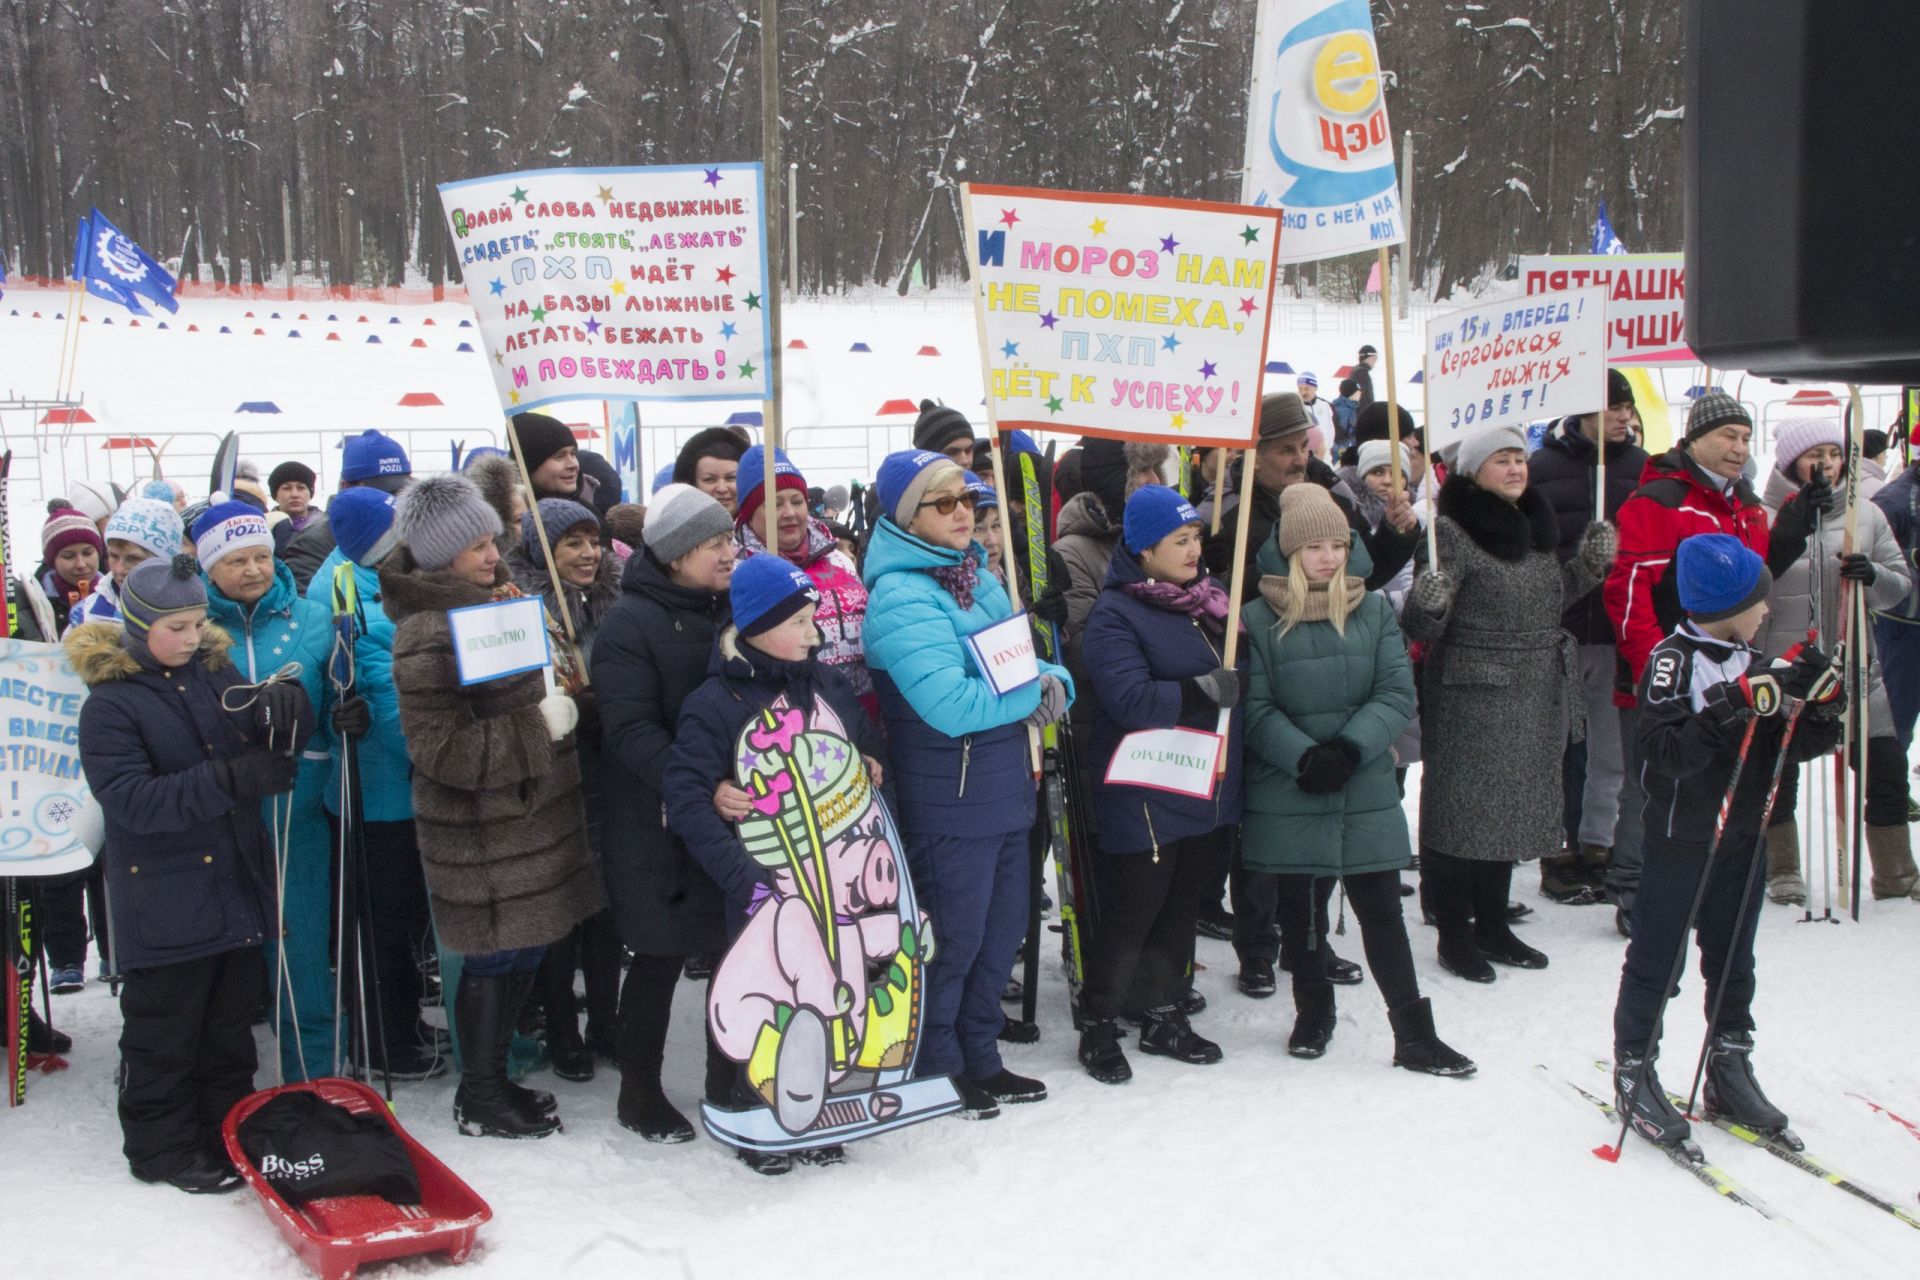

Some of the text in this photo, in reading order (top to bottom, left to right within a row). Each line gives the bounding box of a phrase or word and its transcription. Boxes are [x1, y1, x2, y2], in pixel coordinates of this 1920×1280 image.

[525, 201, 595, 219] СЛОВА
[1334, 203, 1365, 224] НЕЙ
[1370, 218, 1396, 240] МЫ
[511, 256, 696, 286] ПХП ИДЁТ
[978, 229, 1266, 290] И МОРОЗ НАМ
[504, 294, 735, 320] НА БАЗЫ ЛЫЖНЫЕ
[987, 282, 1245, 335] НЕ ПОМЕХА,
[506, 325, 704, 353] ЛЕТАТЬ, БЕЖАТЬ
[1608, 311, 1686, 350] ЧШИ
[1061, 331, 1156, 367] ПХП
[512, 349, 726, 388] И ПОБЕЖДАТЬ!
[991, 362, 1240, 416] ДЁТ К УСПЕХУ!
[225, 524, 268, 542] POZIS
